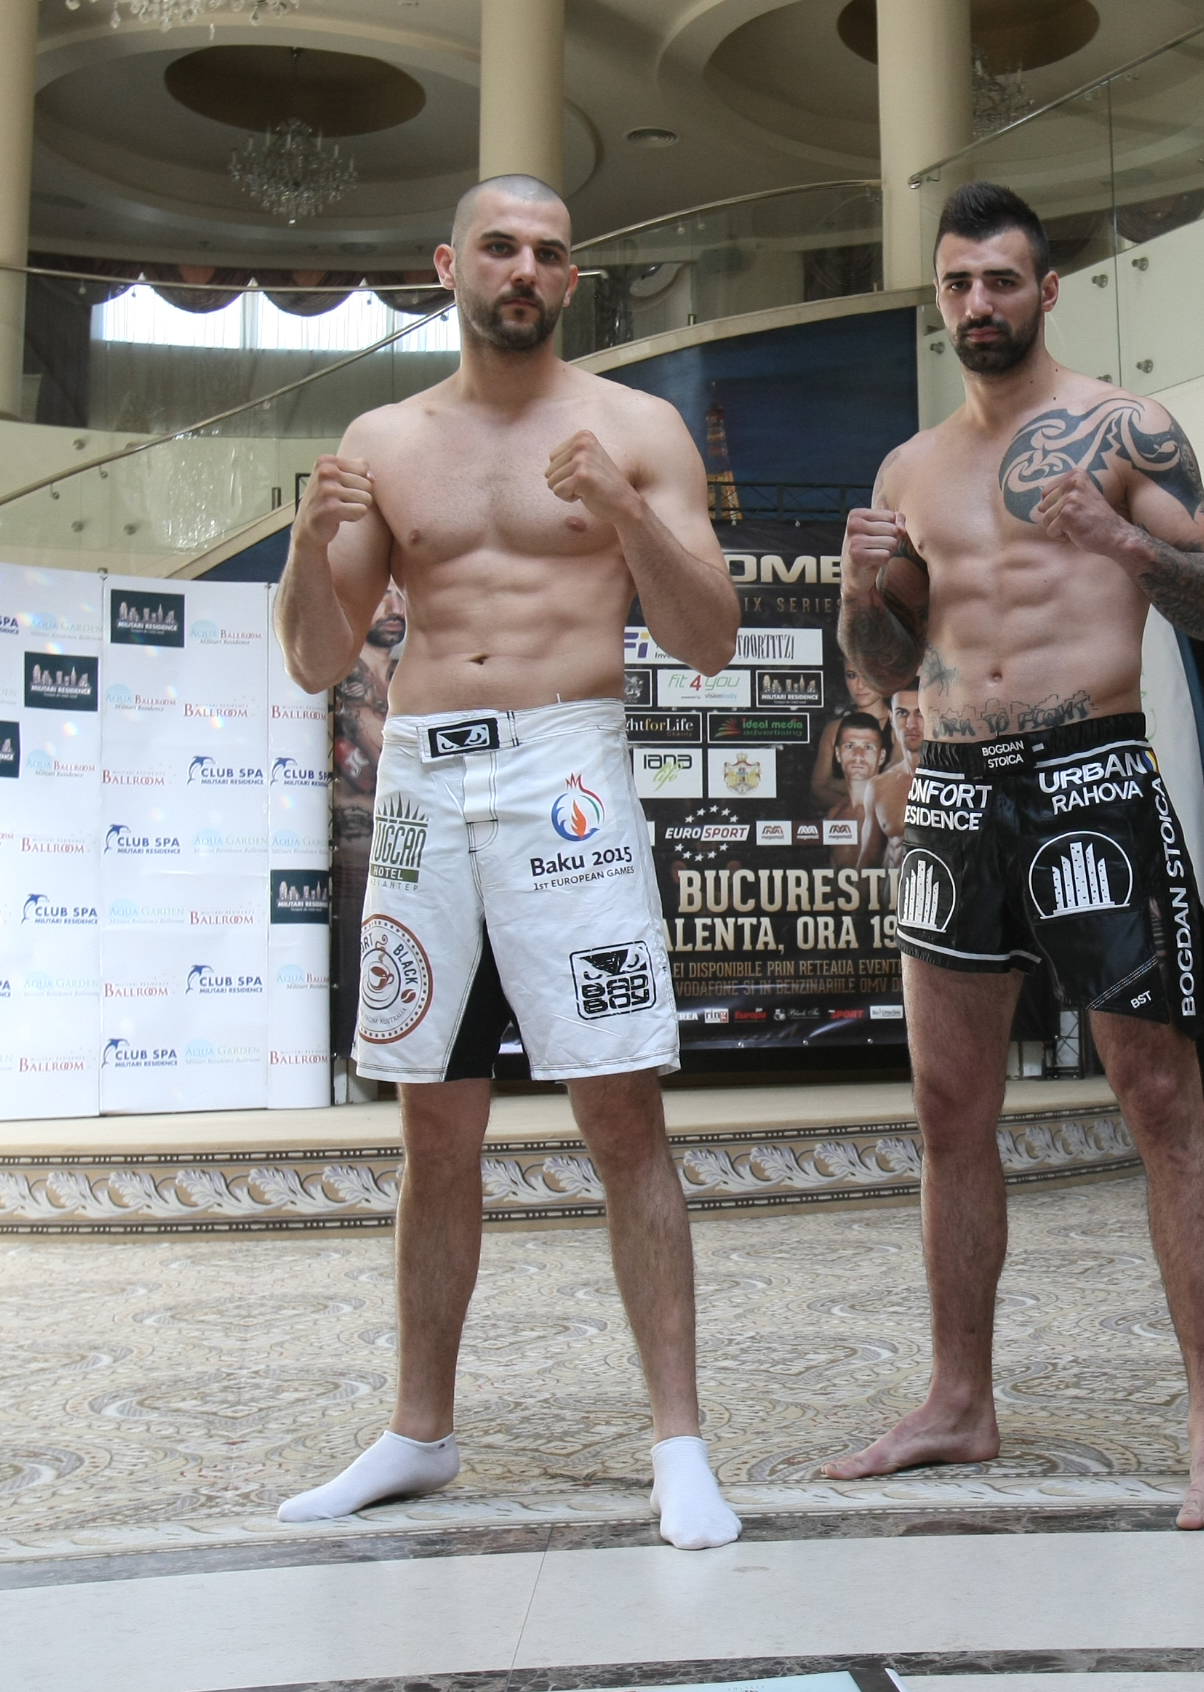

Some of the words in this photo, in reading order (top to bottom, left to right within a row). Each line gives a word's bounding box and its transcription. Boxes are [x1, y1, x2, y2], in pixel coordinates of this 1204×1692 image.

[145, 623, 178, 631] RESIDENCE
[220, 630, 261, 639] BALLROOM
[690, 675, 701, 691] 4
[135, 695, 176, 706] BALLROOM
[183, 704, 248, 718] BALLROOM
[743, 718, 769, 729] ideal
[771, 718, 803, 729] media
[981, 712, 1010, 734] TO
[743, 729, 802, 738] advertising
[982, 741, 1024, 757] BOGDAN
[54, 761, 95, 771] BALLROOM
[987, 754, 1024, 768] STOICA
[102, 769, 165, 785] BALLROOM
[201, 768, 234, 778] CLUB
[239, 768, 264, 778] SPA
[284, 769, 315, 779] CLUB
[1039, 752, 1148, 793] URBAN
[907, 778, 992, 808] ONFORT
[1051, 780, 1144, 815] RAHOVA
[1151, 778, 1185, 878] STOICA
[21, 837, 84, 853] BALLROOM
[117, 837, 149, 847] CLUB
[155, 837, 180, 847] SPA
[530, 852, 585, 877] Baku
[591, 846, 632, 867] 2015
[373, 866, 403, 880] HOTEL
[551, 871, 605, 888] EUROPEAN
[606, 866, 635, 878] GAMES
[35, 907, 68, 917] CLUB
[73, 907, 98, 917] SPA
[190, 911, 254, 925] BALLROOM
[797, 916, 859, 949] ORA
[1169, 887, 1196, 1017] BOGDAN
[392, 944, 418, 985] BLACK
[689, 961, 763, 979] DISPONIBILE
[767, 961, 794, 977] PRIN
[799, 960, 854, 976] RETEAUA
[199, 976, 232, 986] CLUB
[238, 976, 263, 986] SPA
[581, 974, 649, 999] BAD
[677, 981, 738, 997] VODAFONE
[743, 980, 757, 995] SI
[760, 980, 771, 995] IN
[860, 978, 887, 992] OMV
[104, 983, 168, 998] BALLROOM
[583, 989, 650, 1014] BOY
[1130, 991, 1152, 1009] BST
[831, 1010, 864, 1019] SPORT
[115, 1050, 147, 1060] CLUB
[152, 1049, 177, 1060] SPA
[270, 1051, 328, 1065] BALLROOM
[19, 1057, 84, 1072] BALLROOM
